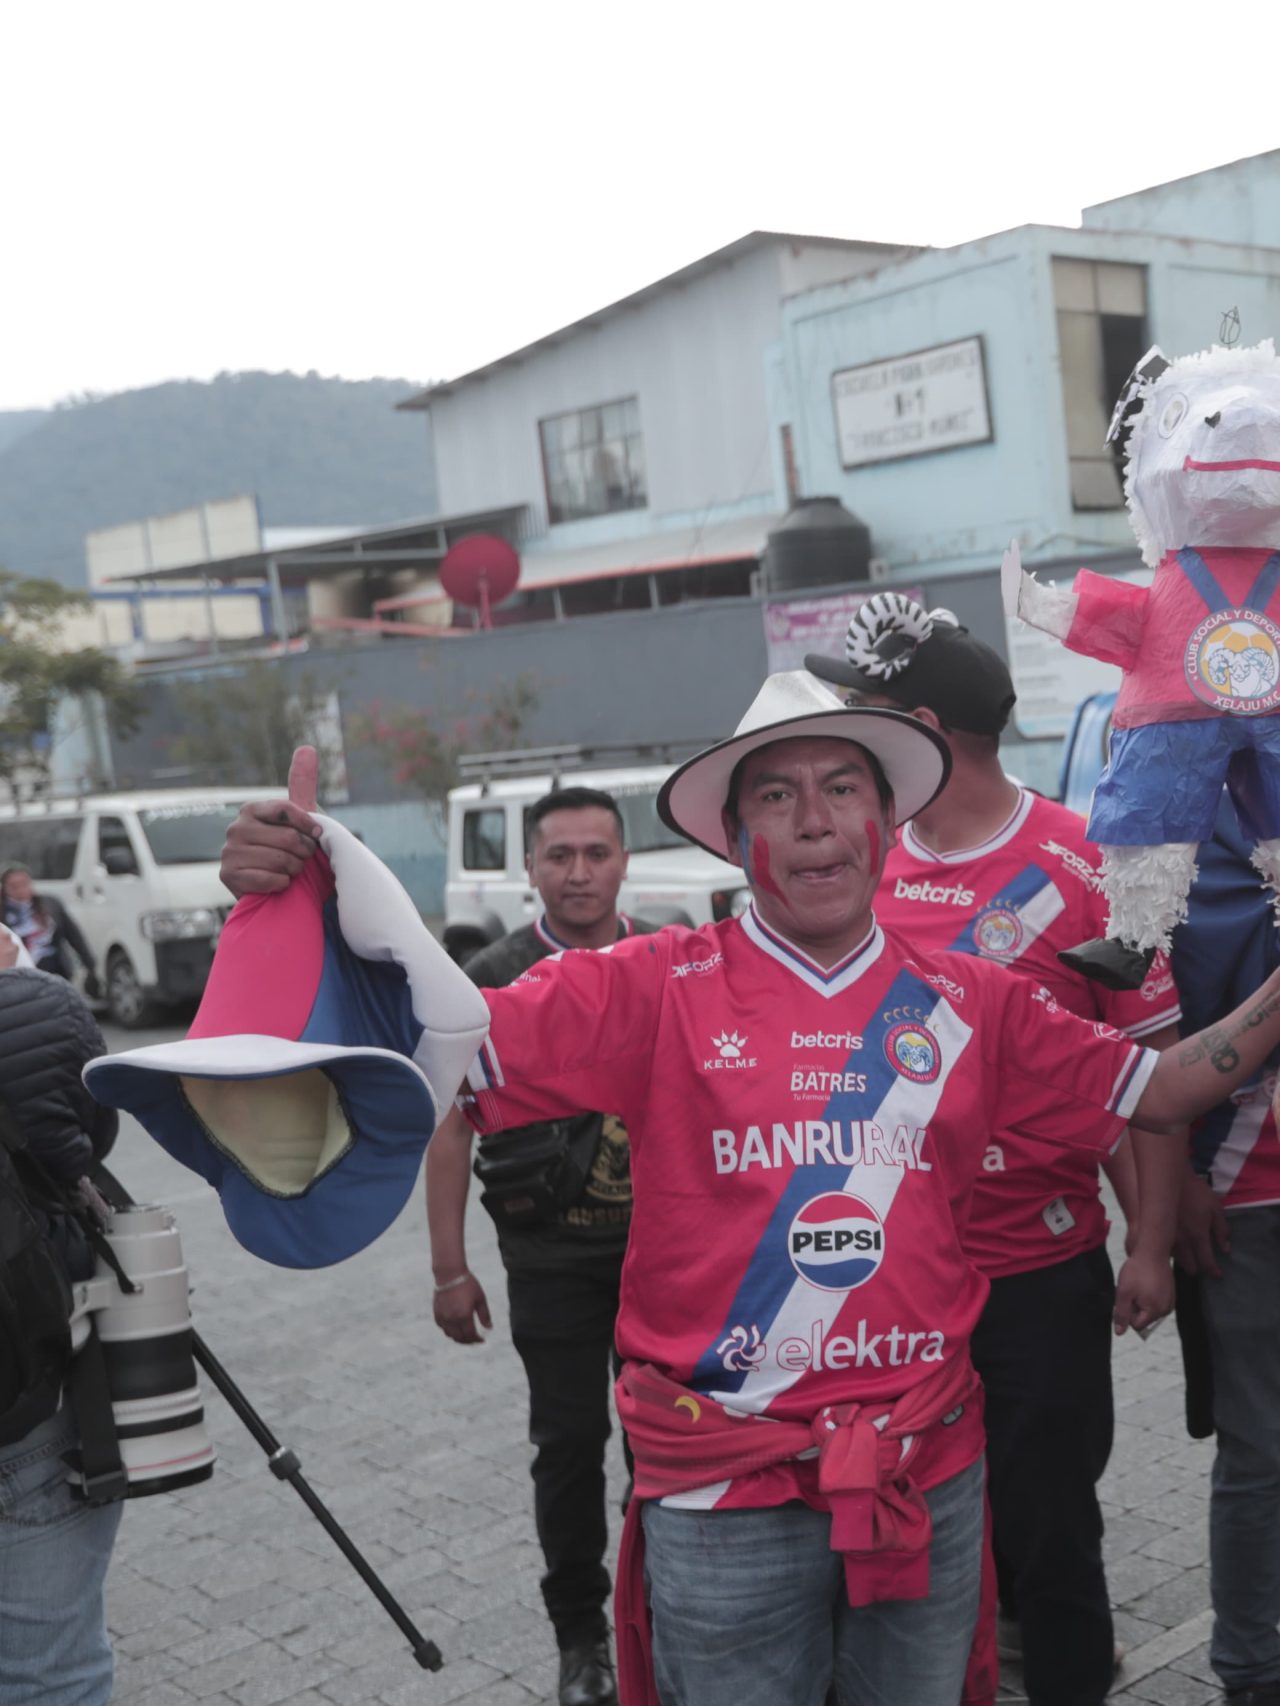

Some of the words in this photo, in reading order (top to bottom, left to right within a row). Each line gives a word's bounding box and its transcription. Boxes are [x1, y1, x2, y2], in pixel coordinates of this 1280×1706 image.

[1187, 643, 1200, 674] CLUB
[1195, 611, 1232, 642] SOCIAL
[1233, 609, 1241, 619] Y
[1213, 695, 1260, 711] XELAJU
[892, 877, 977, 907] betcris
[790, 1030, 864, 1050] betcris
[790, 1071, 867, 1094] BATRES
[712, 1120, 933, 1175] BANRURAL
[792, 1229, 882, 1253] PEPSI
[775, 1318, 946, 1373] elektra
